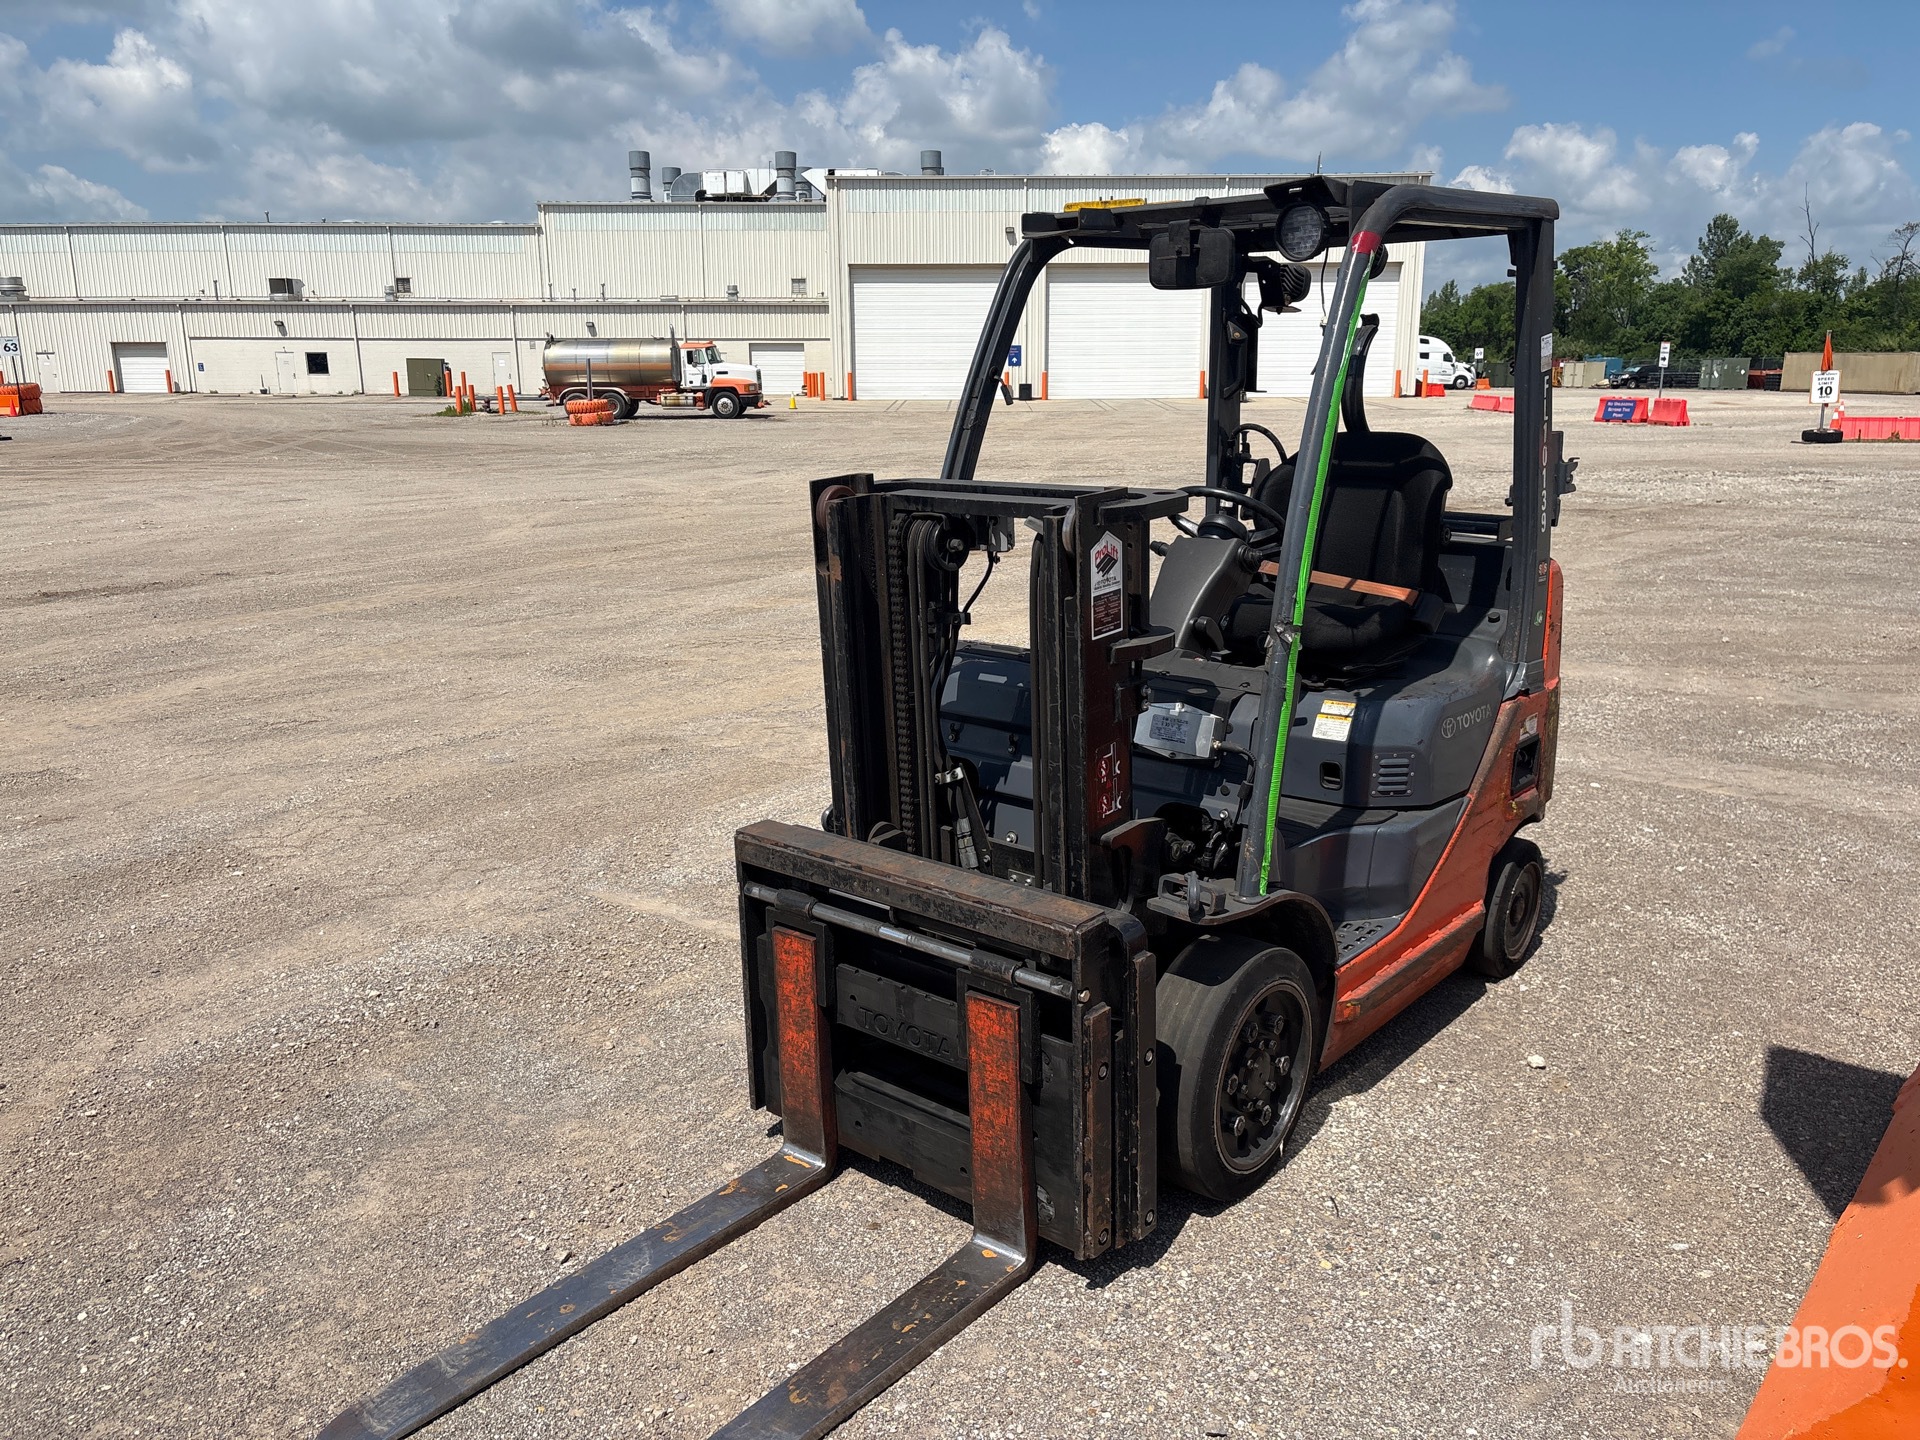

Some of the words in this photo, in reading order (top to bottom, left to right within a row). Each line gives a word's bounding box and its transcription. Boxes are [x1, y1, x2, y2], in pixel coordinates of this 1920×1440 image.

[3, 342, 18, 352] 63
[1817, 385, 1833, 396] 10
[1457, 704, 1492, 730] TOYOTA
[859, 1006, 956, 1061] TOYOTA
